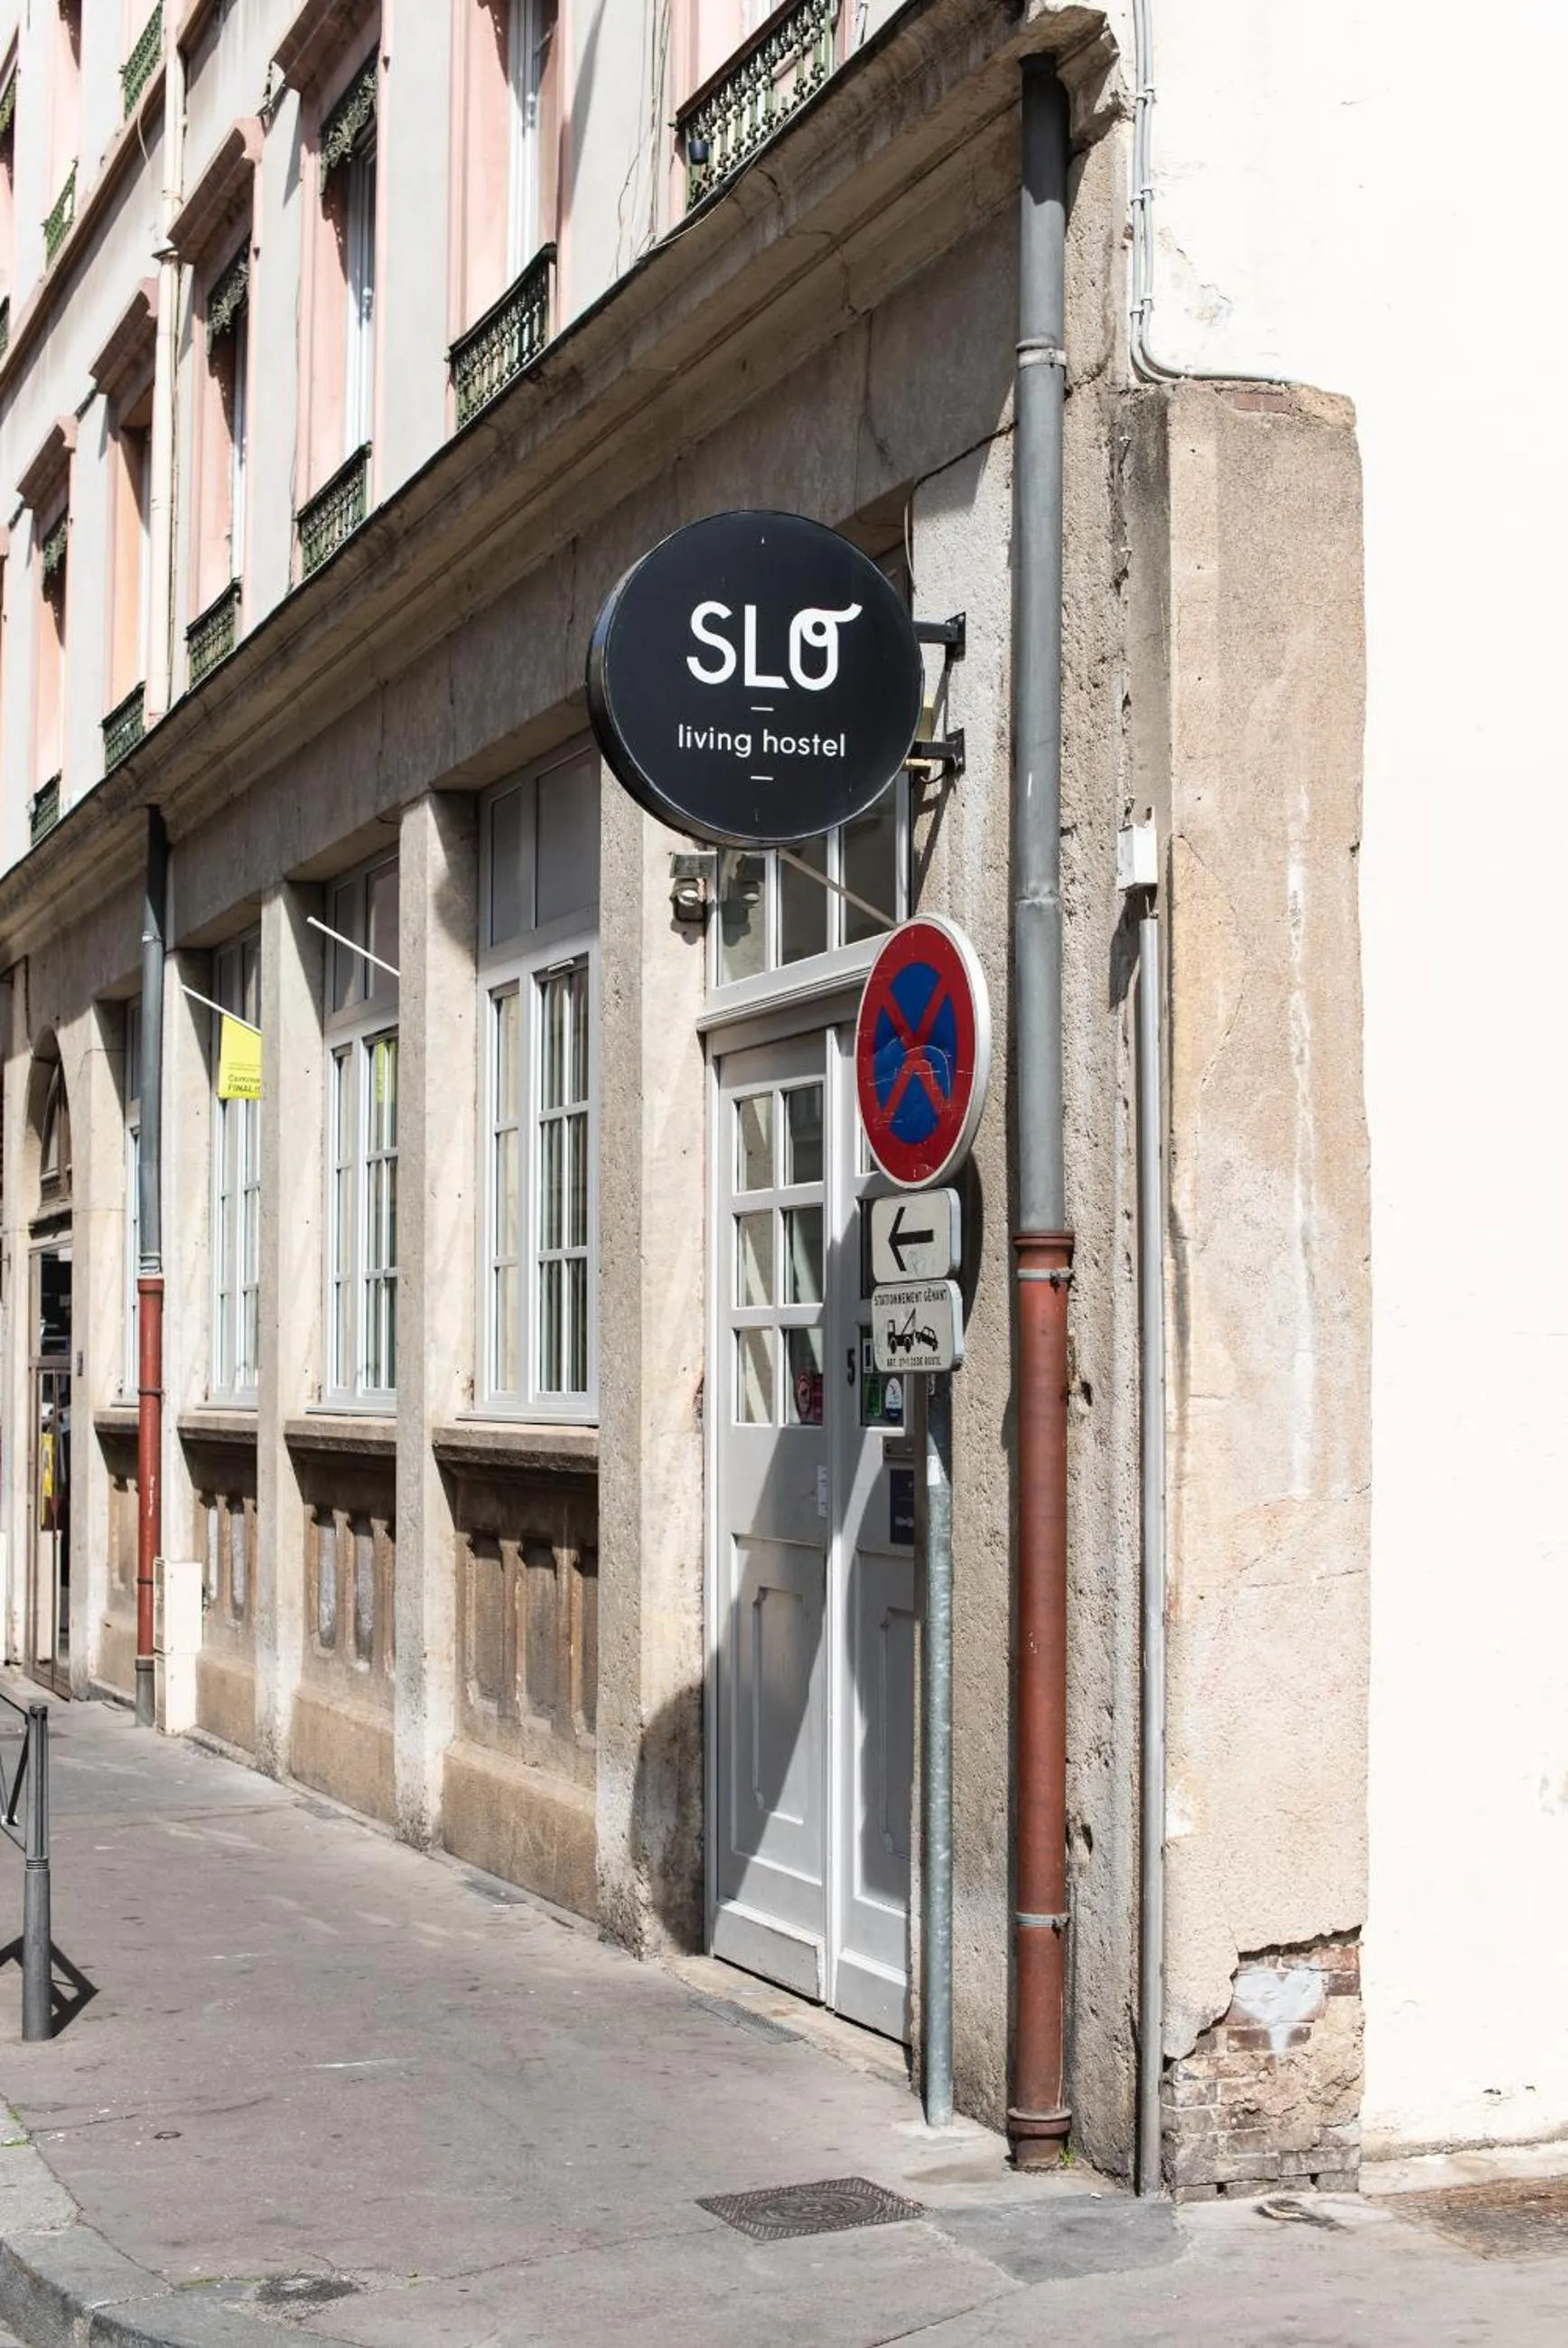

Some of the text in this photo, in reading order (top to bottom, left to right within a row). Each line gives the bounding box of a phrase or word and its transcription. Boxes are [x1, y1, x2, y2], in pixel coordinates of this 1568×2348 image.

[678, 725, 845, 757] living hostel
[846, 1348, 855, 1387] 5
